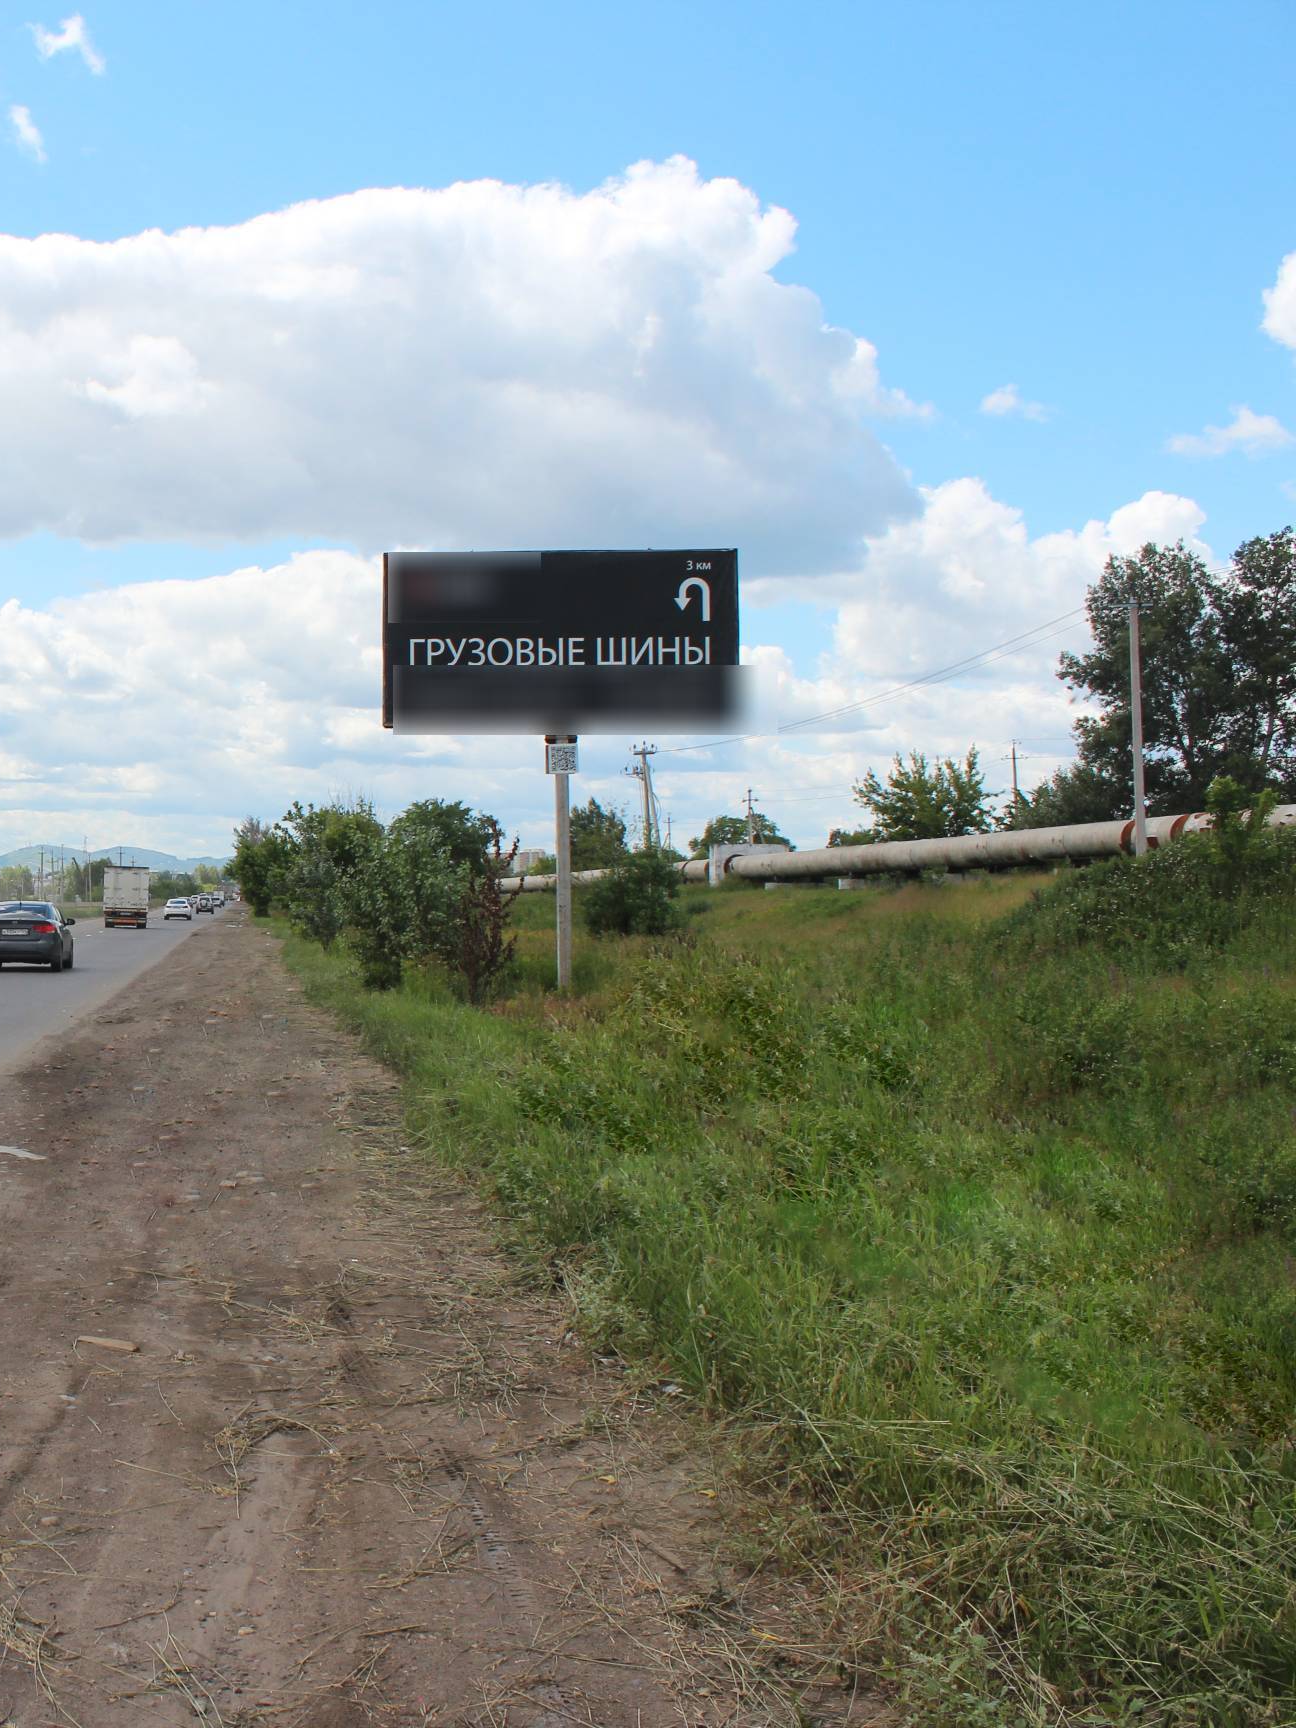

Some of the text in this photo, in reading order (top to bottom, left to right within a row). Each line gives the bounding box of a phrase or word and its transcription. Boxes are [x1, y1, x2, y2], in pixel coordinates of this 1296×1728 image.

[686, 560, 693, 570] 3
[409, 636, 711, 665] ГРУЗОВЫЕ ШИНЫ
